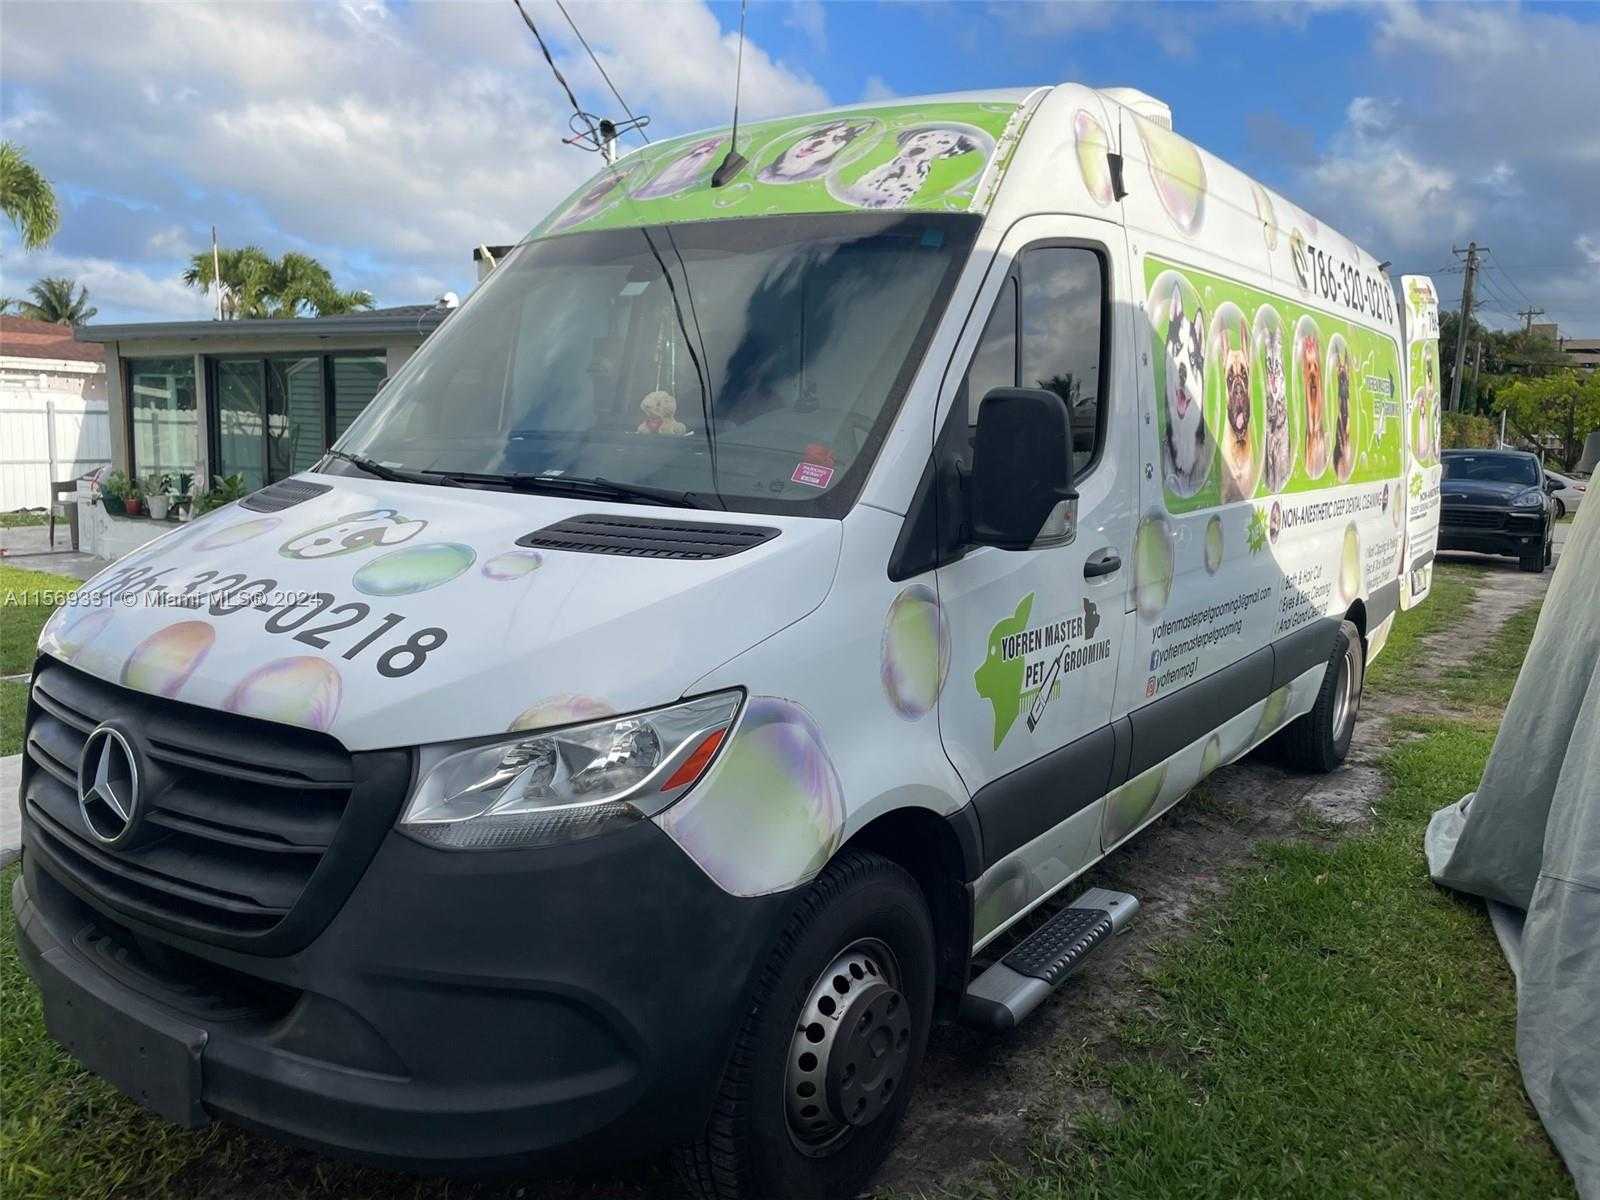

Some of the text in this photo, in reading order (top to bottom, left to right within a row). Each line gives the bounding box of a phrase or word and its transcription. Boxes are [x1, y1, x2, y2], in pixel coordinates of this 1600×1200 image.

[1307, 245, 1394, 325] 786-320-0218
[1001, 616, 1083, 662] YOFREN MASTER
[1025, 639, 1111, 688] PET GROOMING
